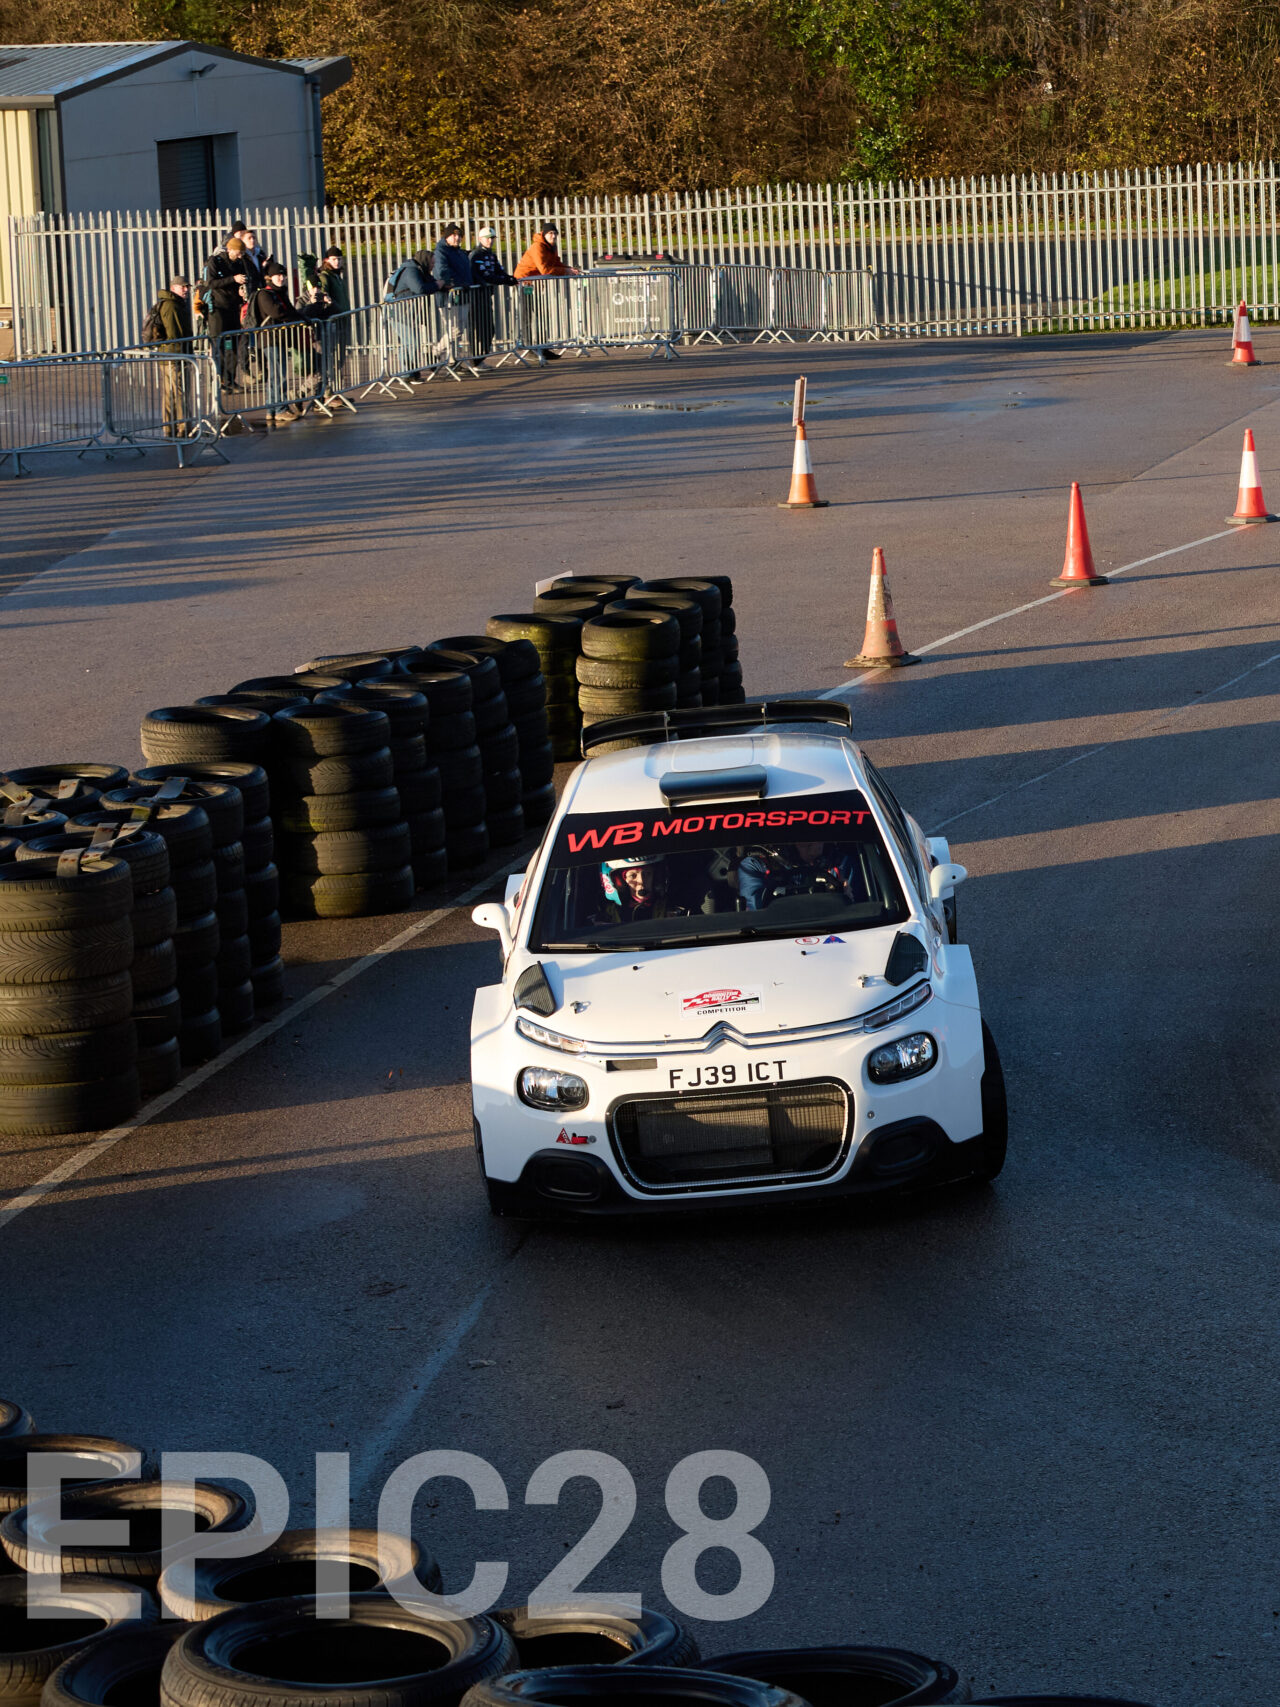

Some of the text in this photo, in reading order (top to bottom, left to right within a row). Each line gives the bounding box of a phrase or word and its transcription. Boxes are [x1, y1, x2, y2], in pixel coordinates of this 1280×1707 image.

[567, 810, 870, 853] WB MOTORSPORT
[697, 1007, 746, 1015] COMPETITOR
[669, 1060, 787, 1089] FJ39 ICT
